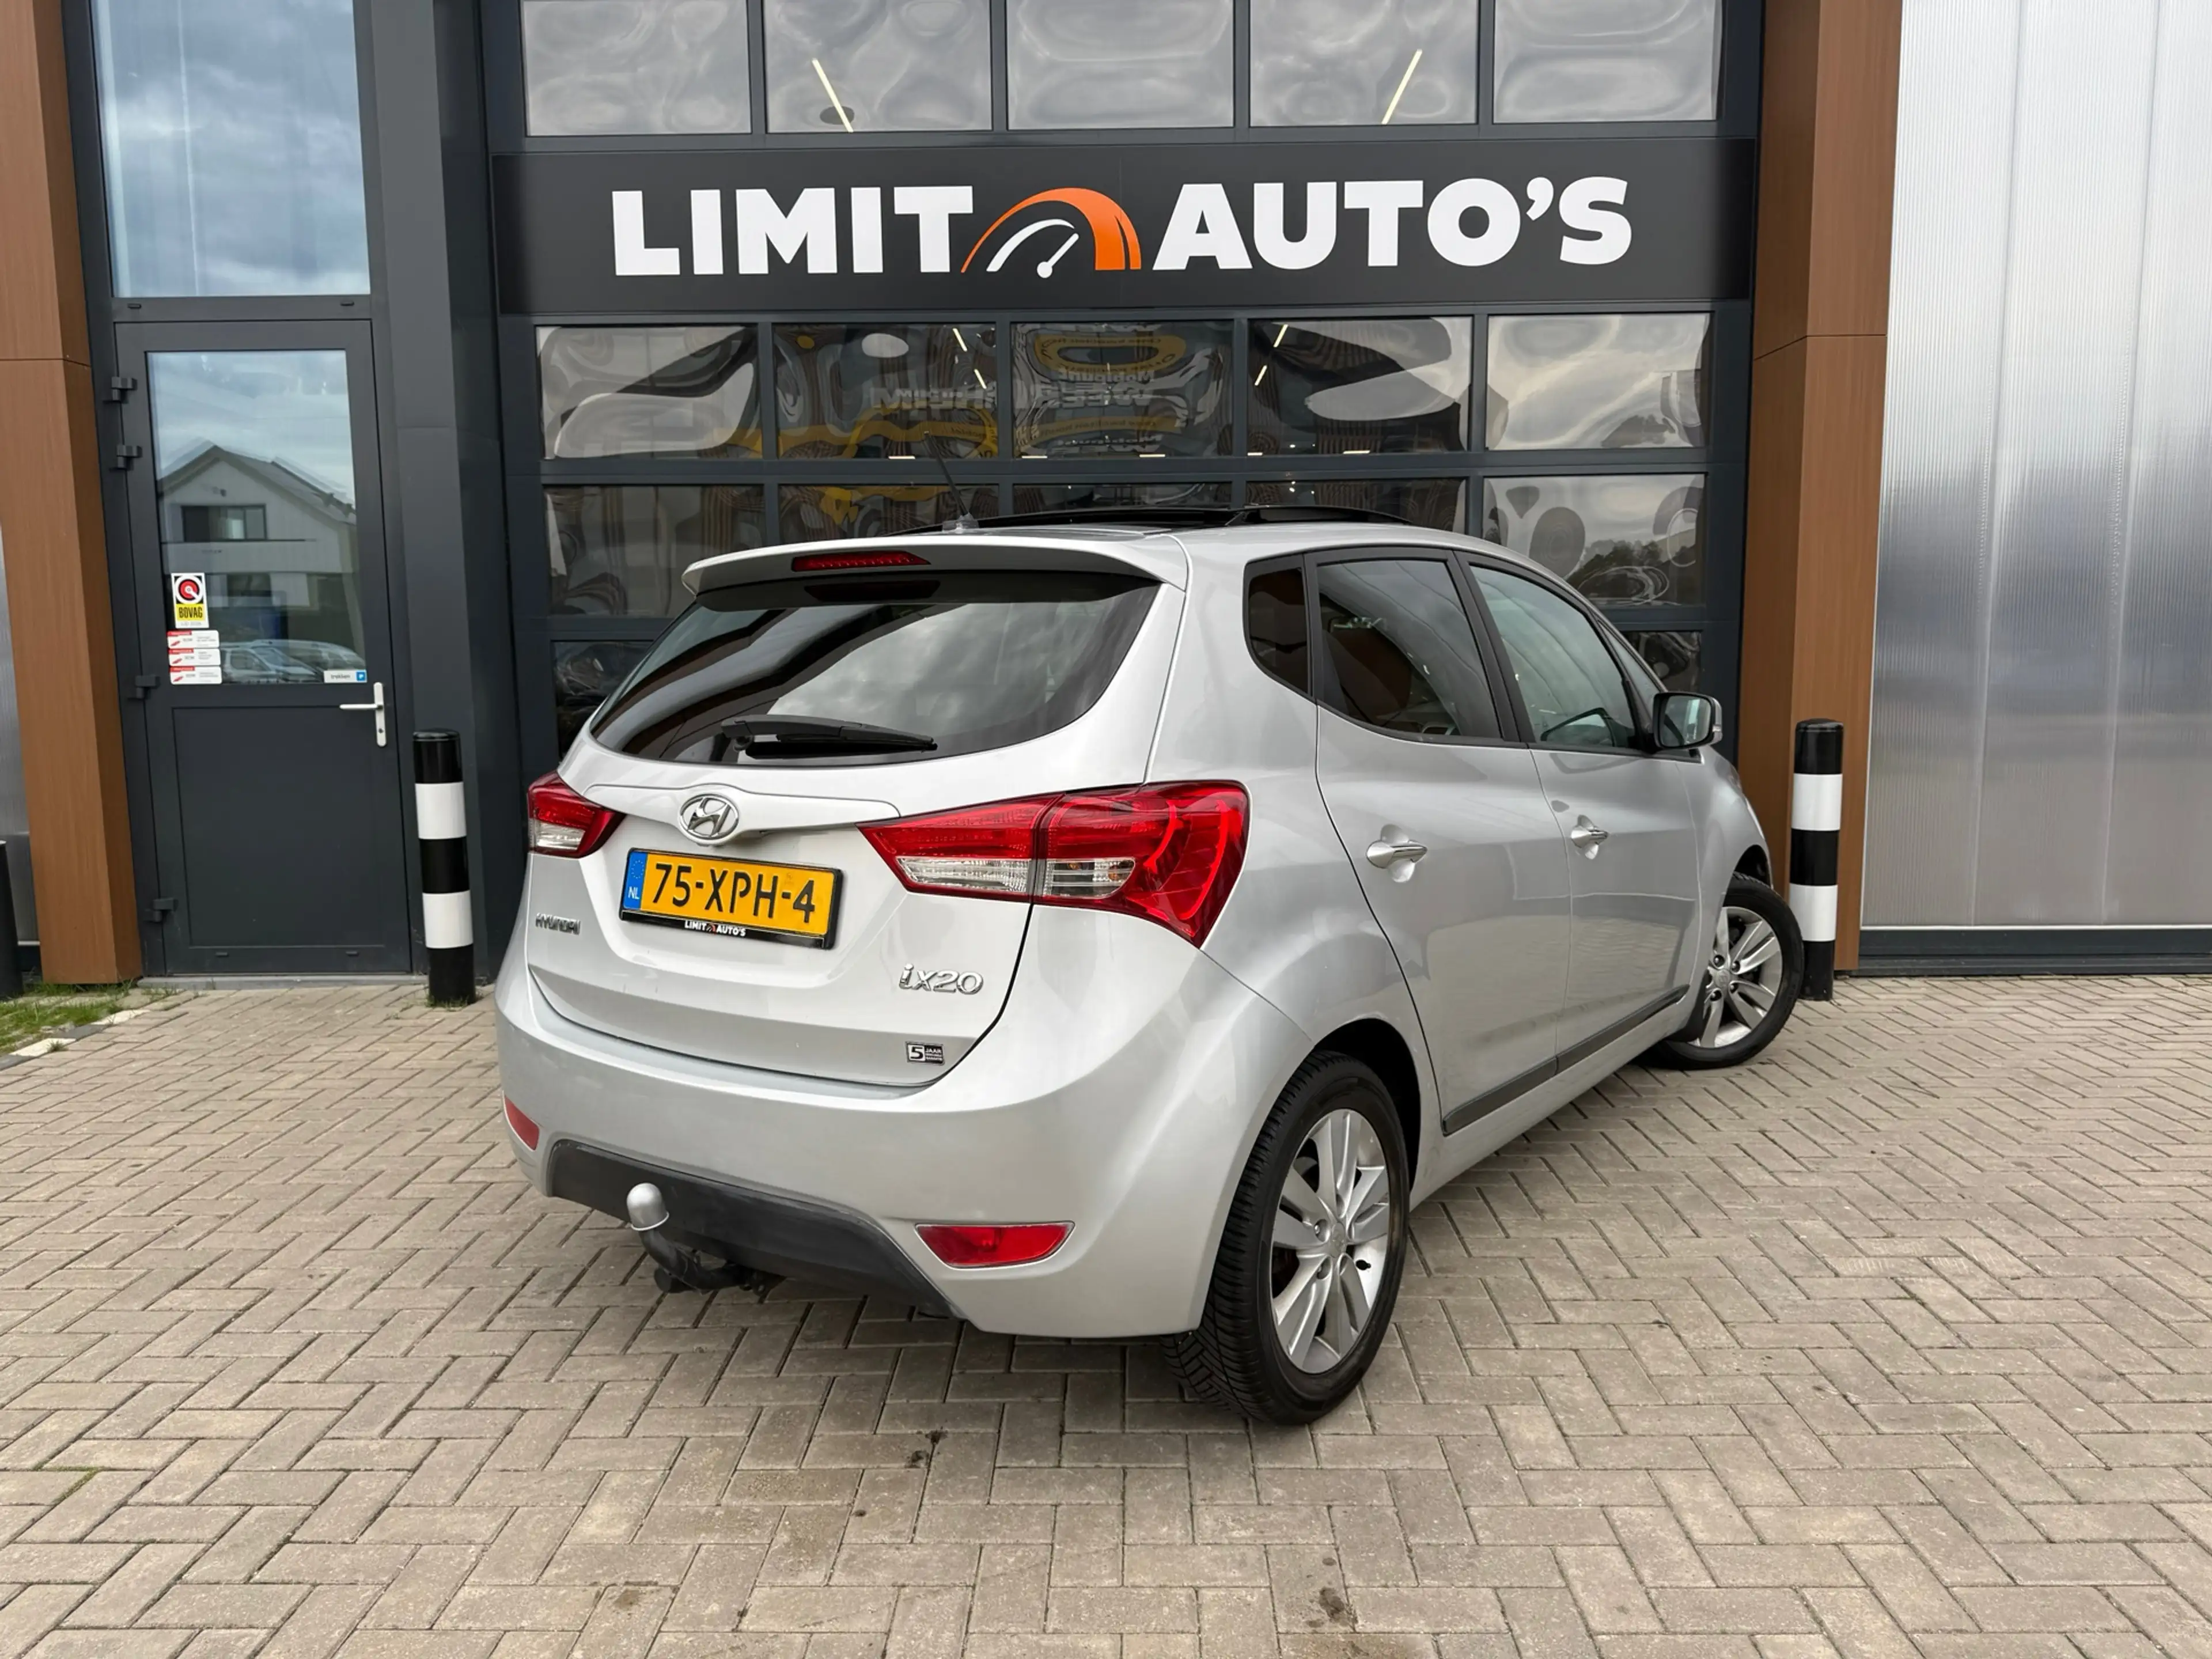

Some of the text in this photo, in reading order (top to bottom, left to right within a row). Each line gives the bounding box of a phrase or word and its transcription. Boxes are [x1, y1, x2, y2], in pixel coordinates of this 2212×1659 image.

[612, 176, 1632, 277] LIMIT AUTO'S
[178, 606, 203, 619] BOVAG
[627, 885, 641, 900] NL
[652, 863, 816, 923] 75-XPH-4
[684, 919, 747, 937] LIMIT AUTO'S
[899, 963, 984, 995] ix20
[910, 1046, 923, 1059] 5
